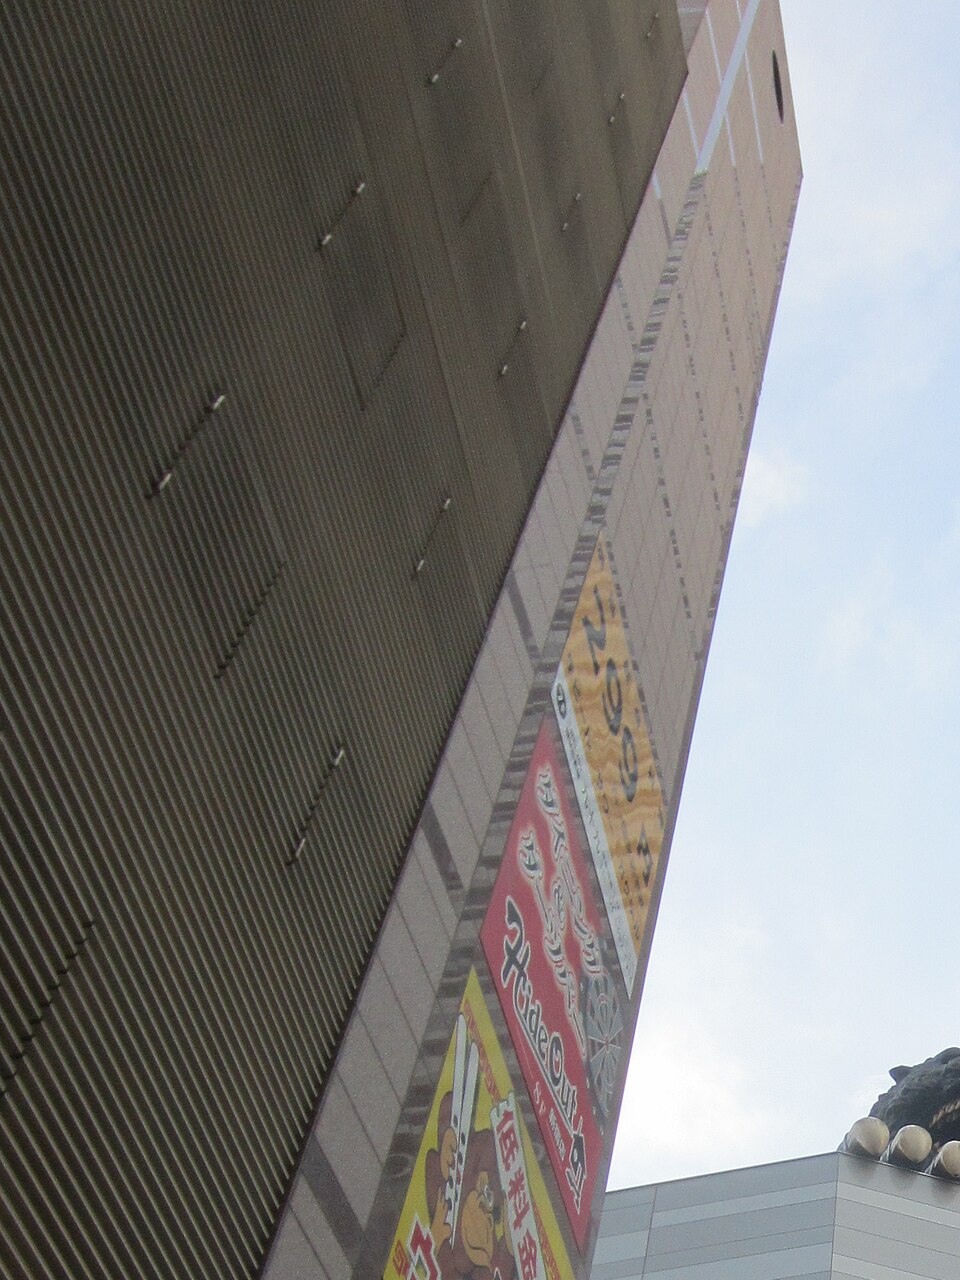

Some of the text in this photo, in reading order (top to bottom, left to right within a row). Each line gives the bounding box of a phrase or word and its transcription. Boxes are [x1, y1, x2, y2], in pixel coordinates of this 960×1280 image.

[519, 827, 587, 1063] ダーツバー
[536, 763, 606, 976] ダイニング
